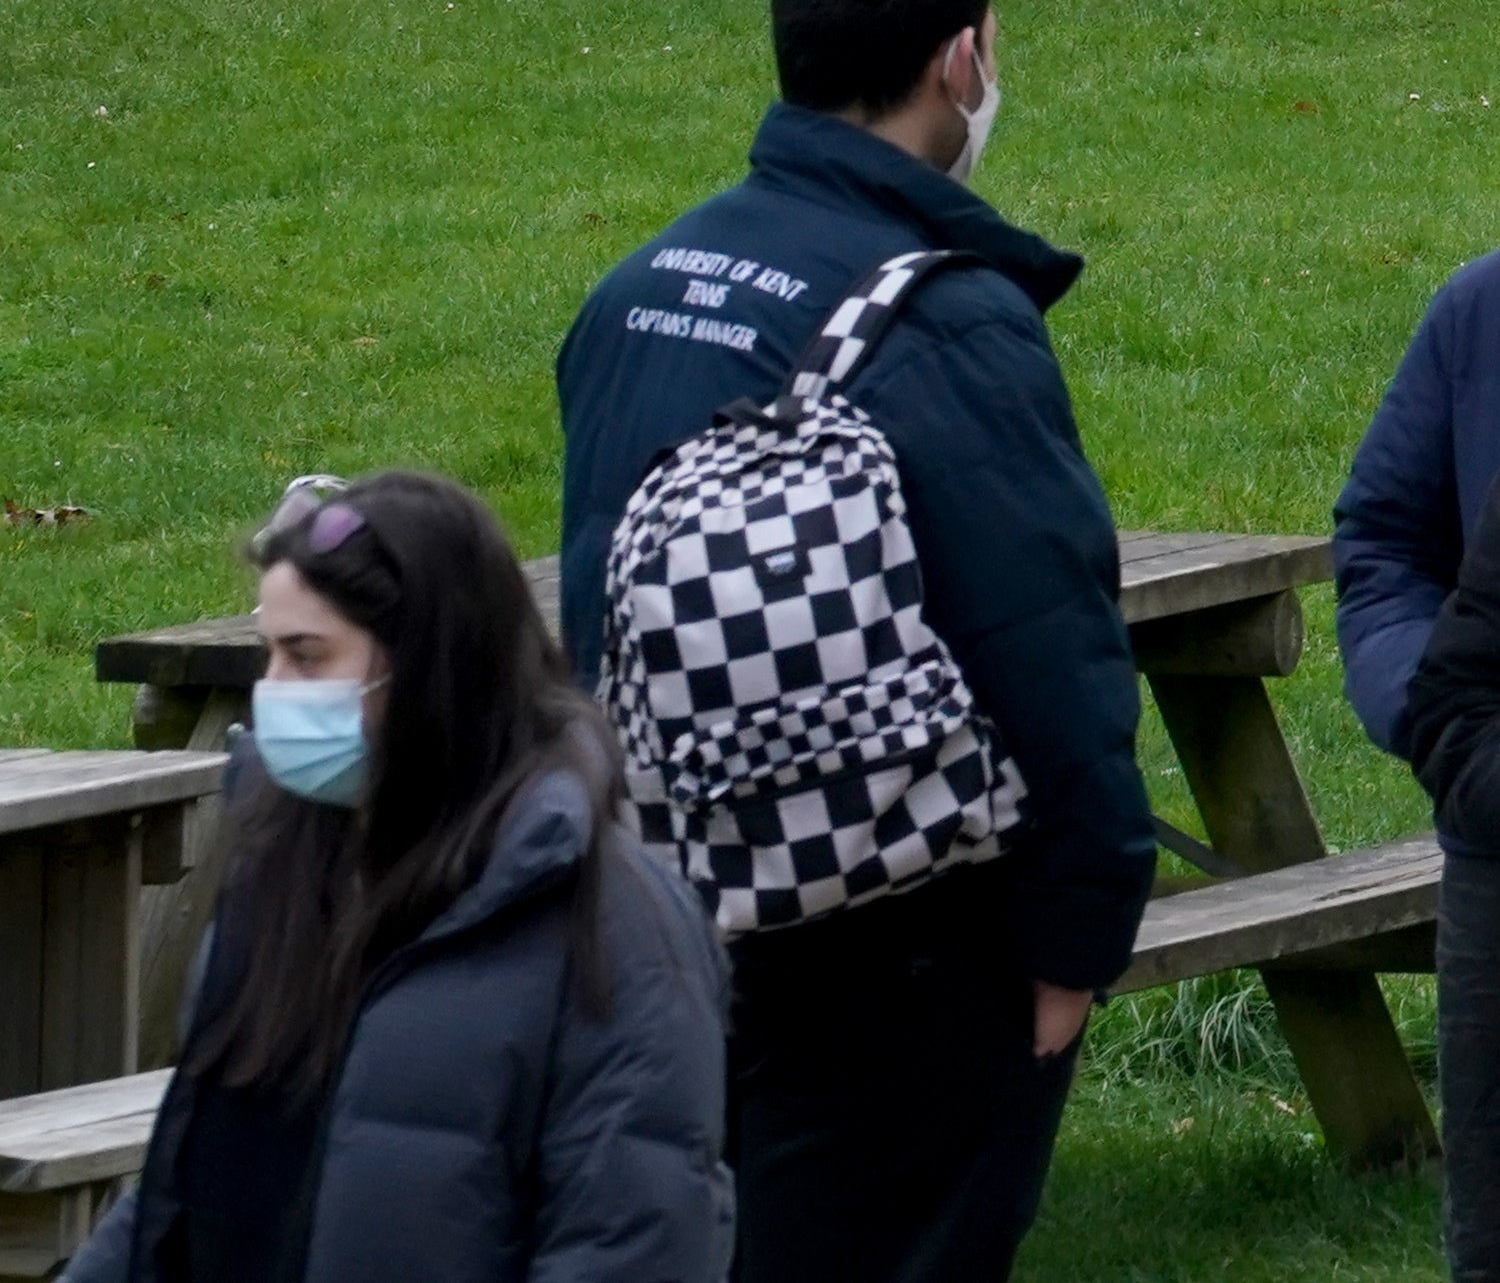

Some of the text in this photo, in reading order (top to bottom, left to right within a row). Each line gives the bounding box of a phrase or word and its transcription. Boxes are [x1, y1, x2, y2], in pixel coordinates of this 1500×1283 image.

[651, 248, 811, 302] UNIVERSITY OF KENT
